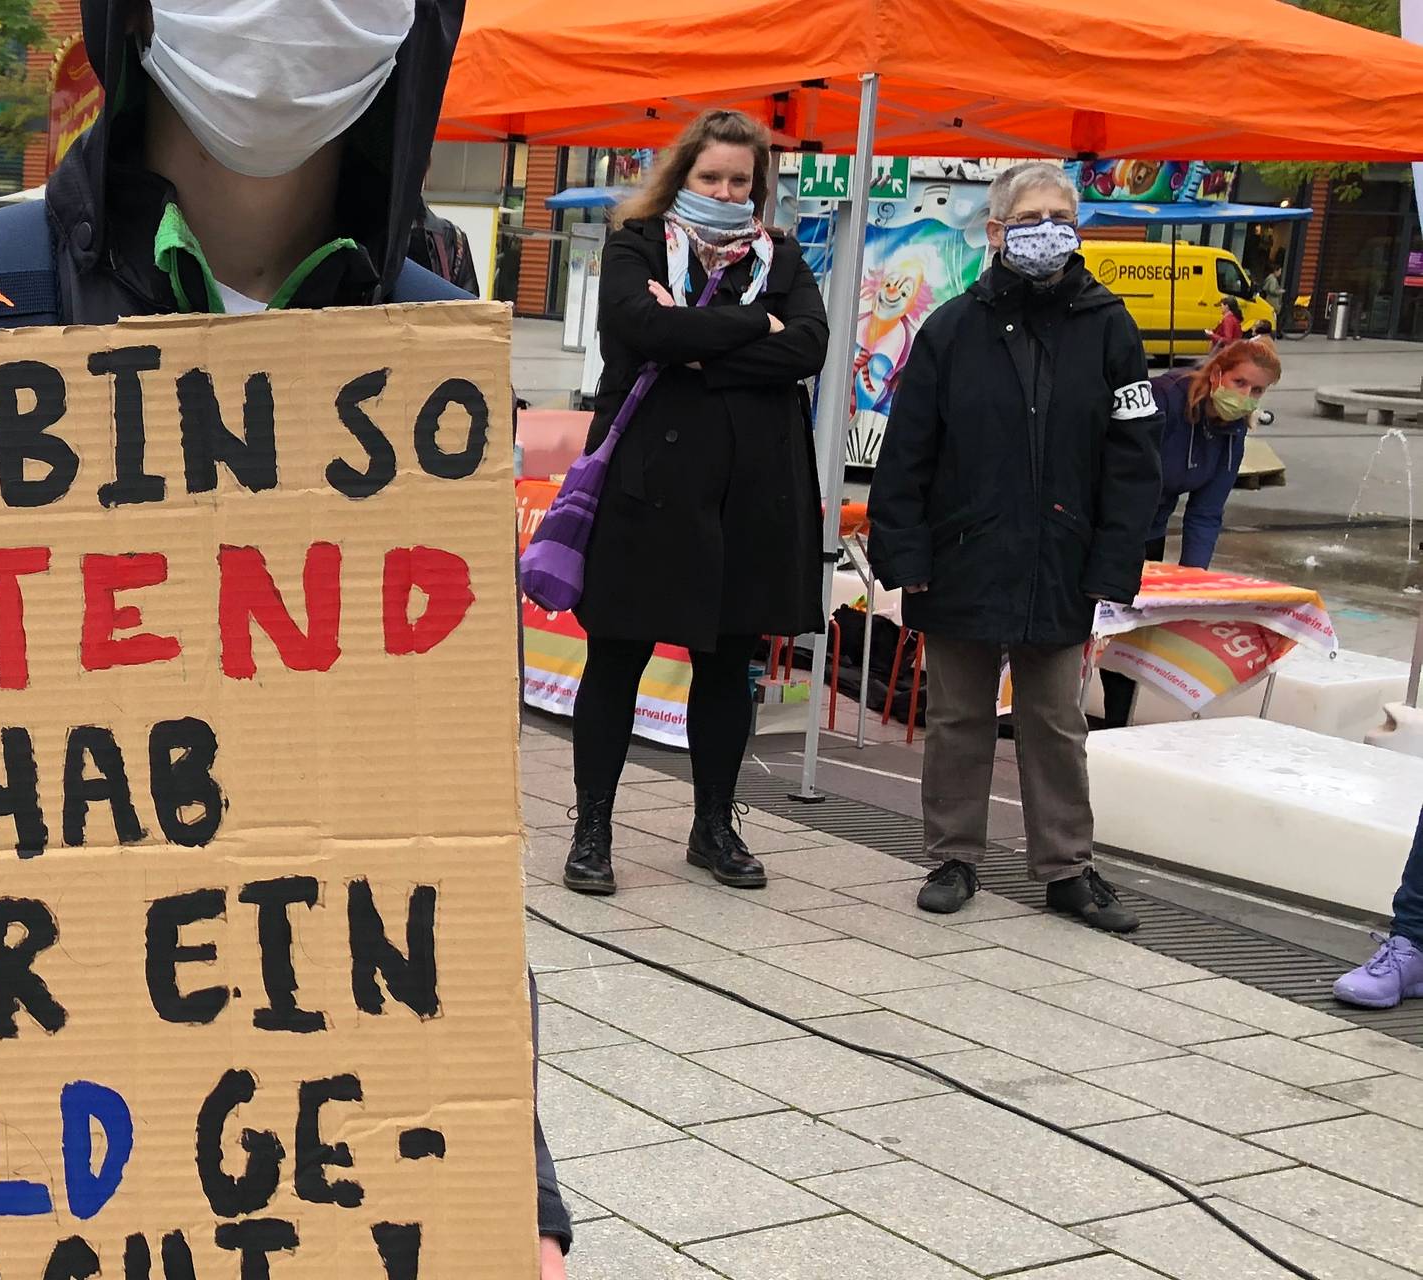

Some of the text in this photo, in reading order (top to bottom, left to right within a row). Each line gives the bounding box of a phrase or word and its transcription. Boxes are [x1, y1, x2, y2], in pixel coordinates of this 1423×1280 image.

[1119, 265, 1190, 280] PROSEGUR
[326, 367, 490, 498] SO
[145, 875, 440, 1034] EIN
